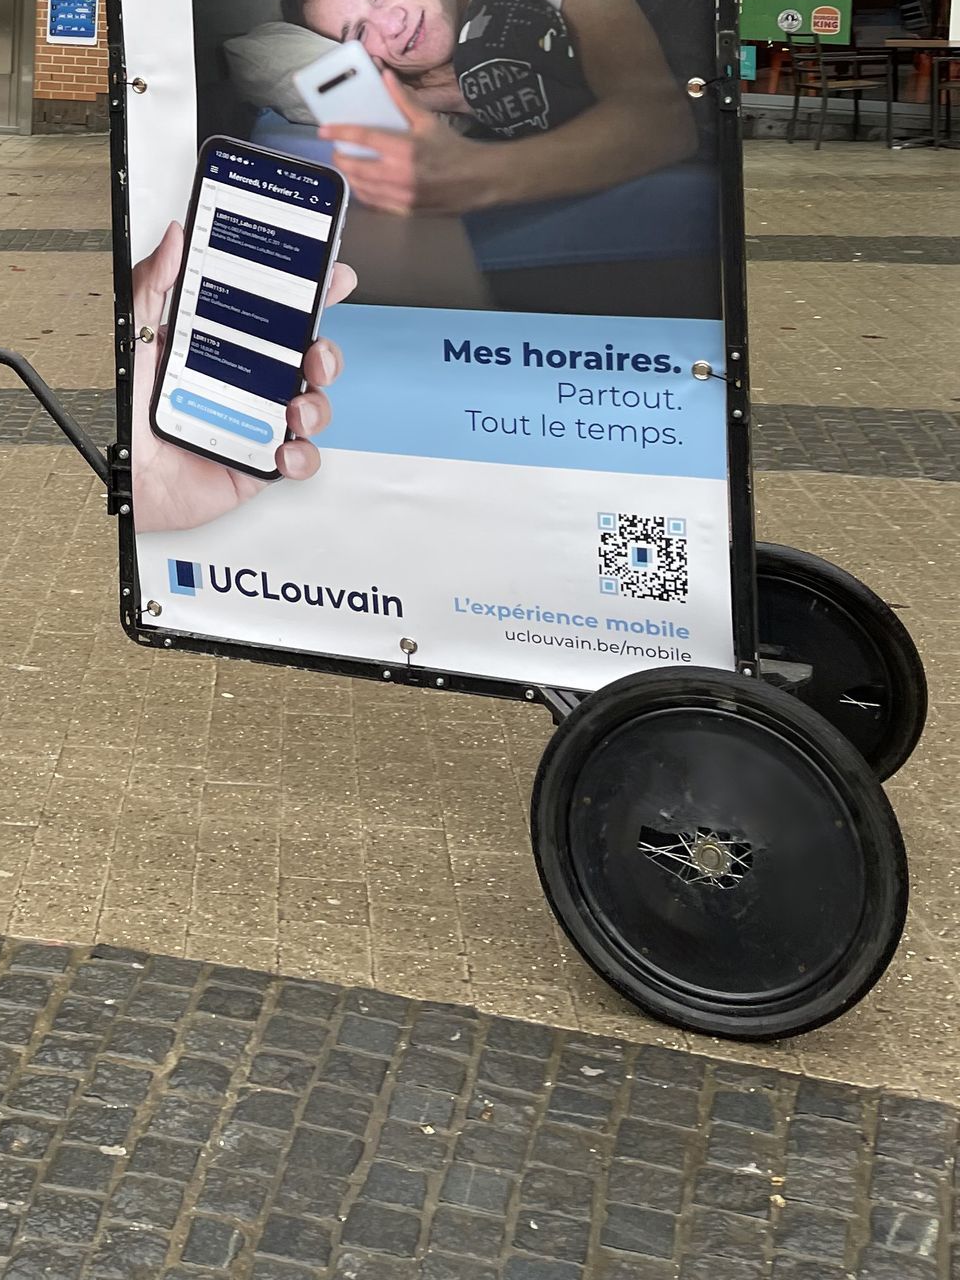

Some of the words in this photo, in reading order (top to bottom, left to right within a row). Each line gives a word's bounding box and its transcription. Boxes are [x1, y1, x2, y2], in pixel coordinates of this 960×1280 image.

[813, 21, 839, 29] KING
[228, 171, 261, 188] Mercredi,
[262, 181, 268, 190] 9
[268, 182, 293, 198] Février
[443, 339, 512, 366] Mes
[523, 341, 682, 374] horaires.
[557, 382, 682, 411] Partout.
[464, 409, 531, 436] Tout
[541, 414, 566, 439] le
[575, 418, 683, 449] temps.
[209, 564, 404, 618] UCLouvain
[606, 617, 690, 640] mobile
[505, 630, 692, 662] uclouvain.be/mobile
